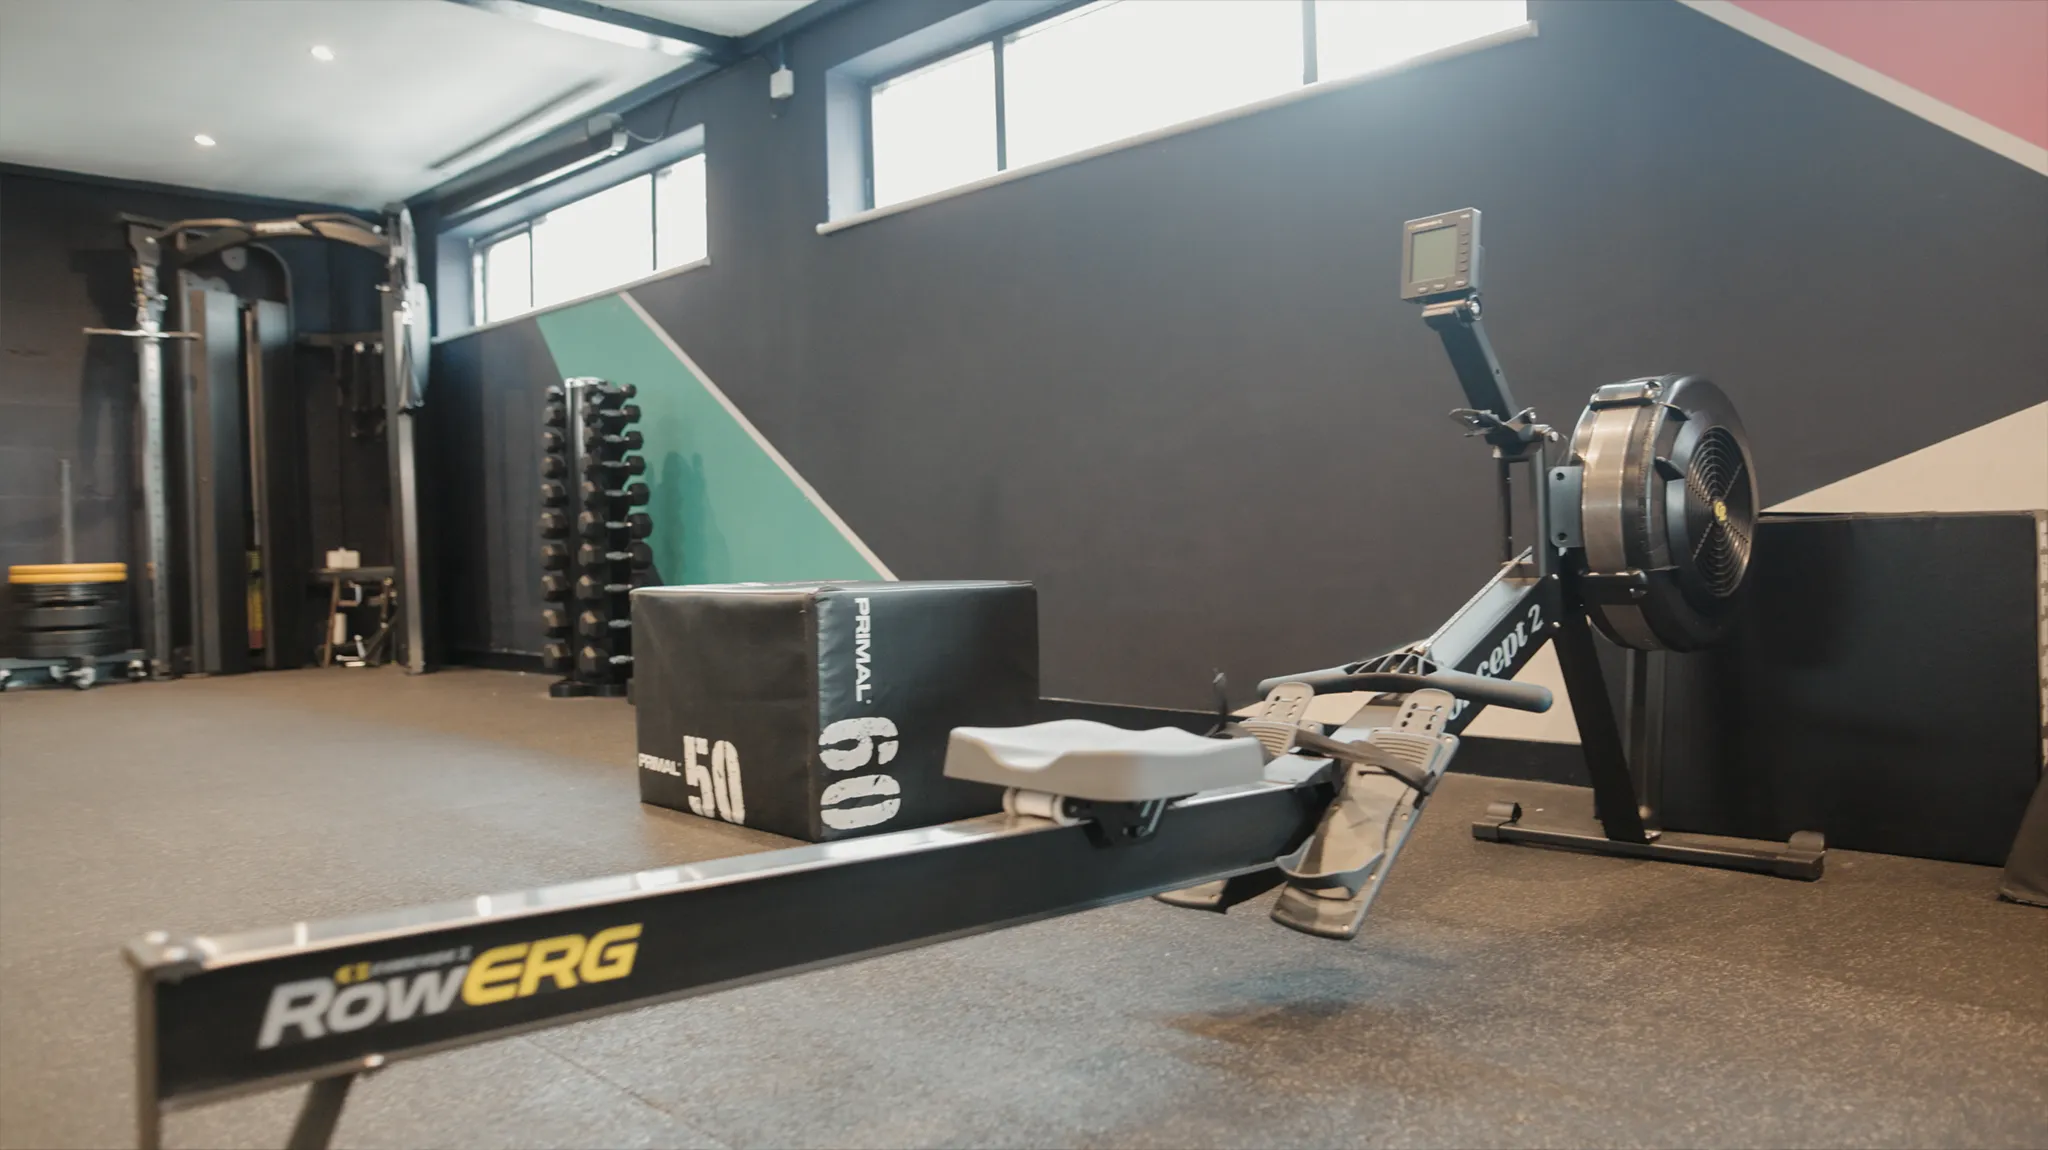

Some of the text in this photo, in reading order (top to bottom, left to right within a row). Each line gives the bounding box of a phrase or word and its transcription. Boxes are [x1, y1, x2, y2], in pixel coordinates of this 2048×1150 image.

[854, 597, 872, 702] PRIMAL
[1528, 603, 1544, 634] 2
[638, 752, 682, 777] PRIMAL
[683, 735, 745, 825] 50
[818, 716, 901, 830] 60
